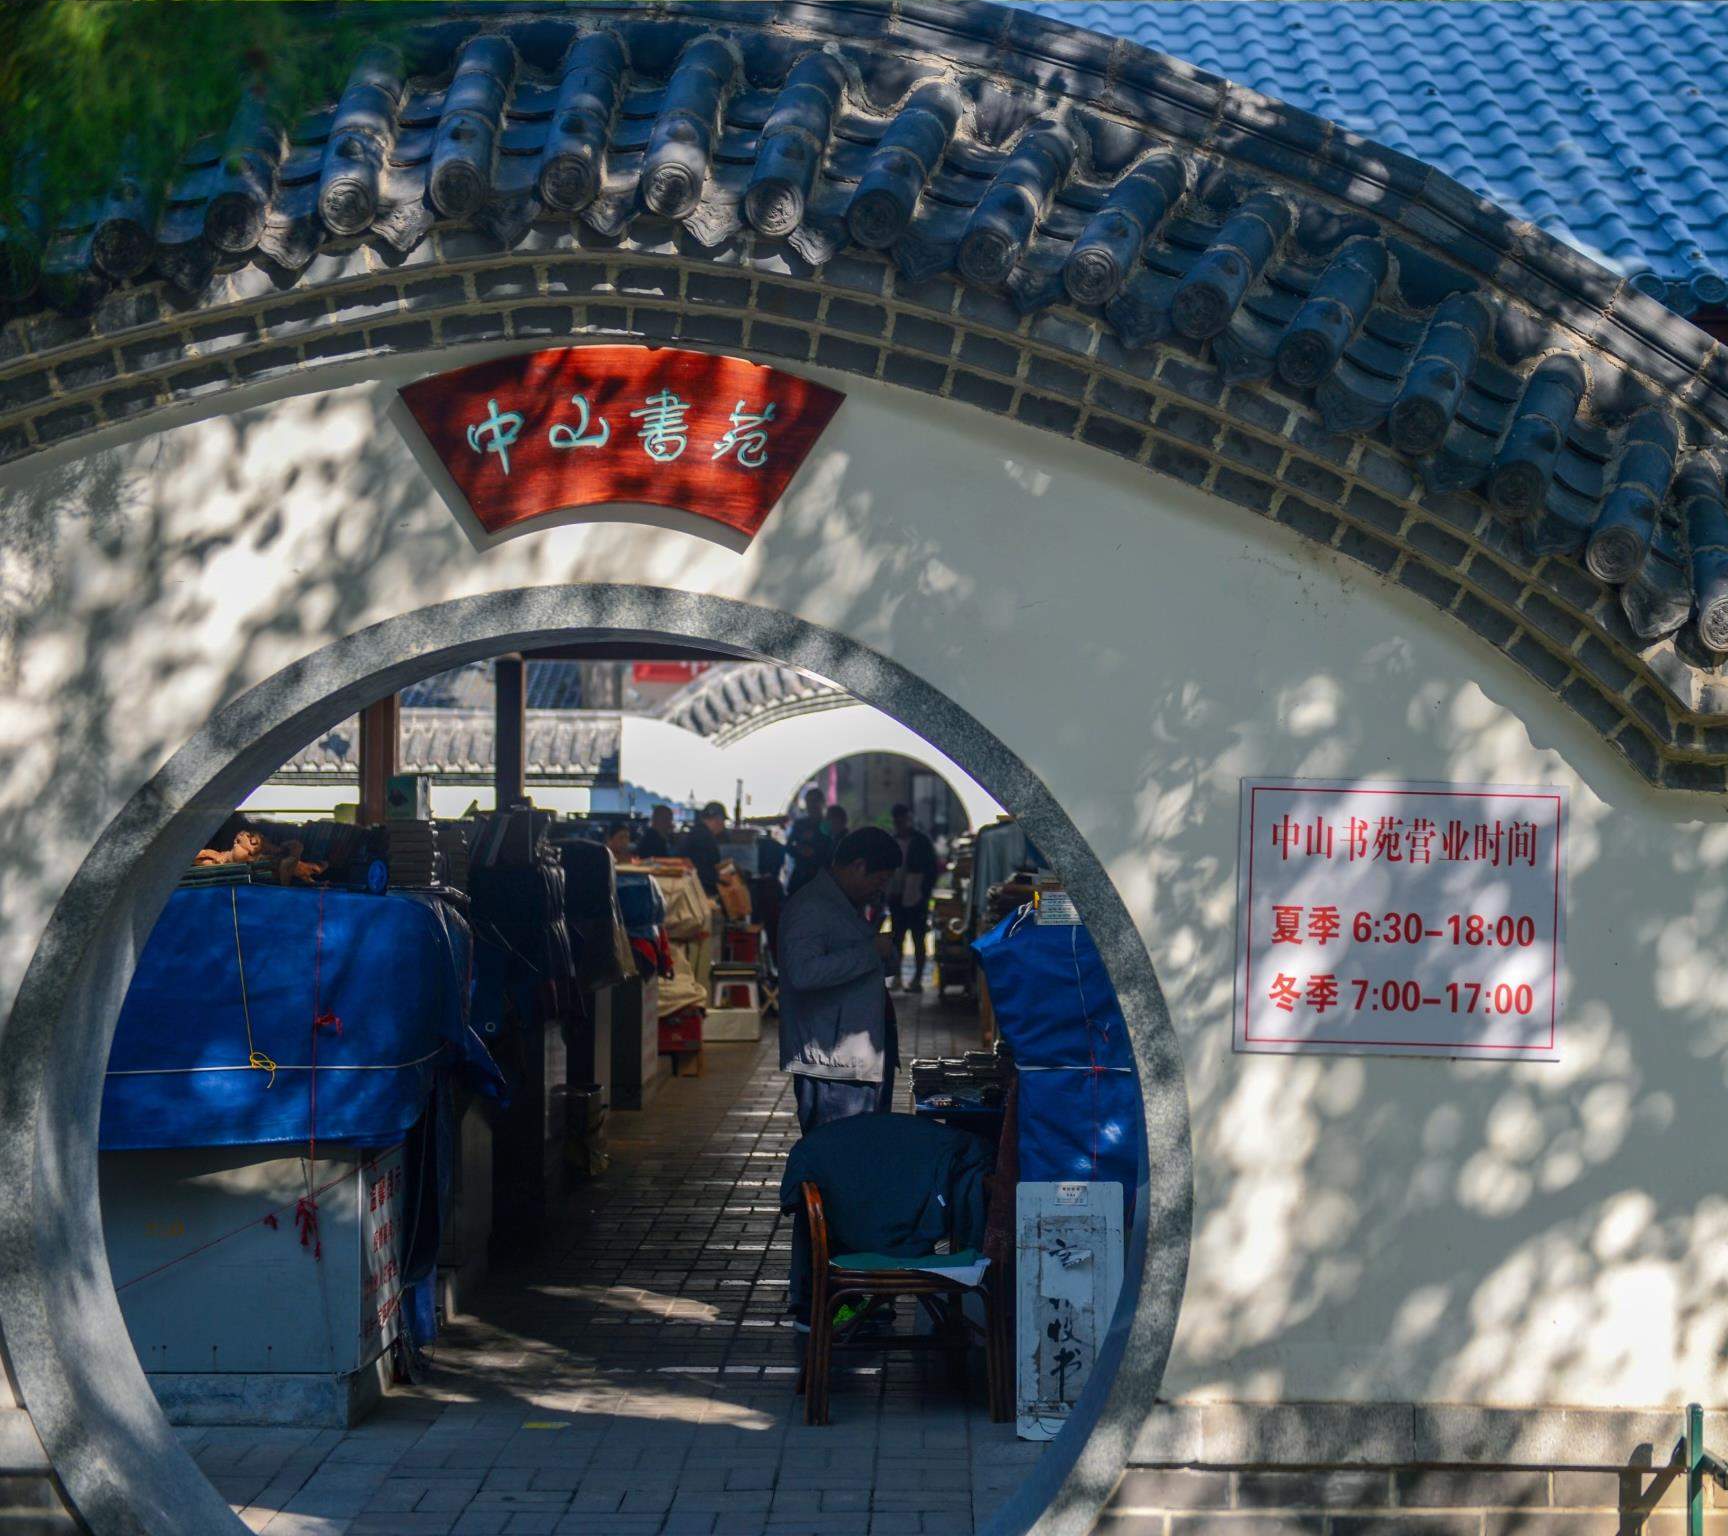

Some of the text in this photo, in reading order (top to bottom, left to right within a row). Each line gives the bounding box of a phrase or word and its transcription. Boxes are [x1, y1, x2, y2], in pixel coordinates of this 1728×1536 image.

[1271, 814, 1538, 867] 中山书苑营业时间
[1271, 904, 1341, 946] 夏季
[1268, 972, 1339, 1014] 冬季
